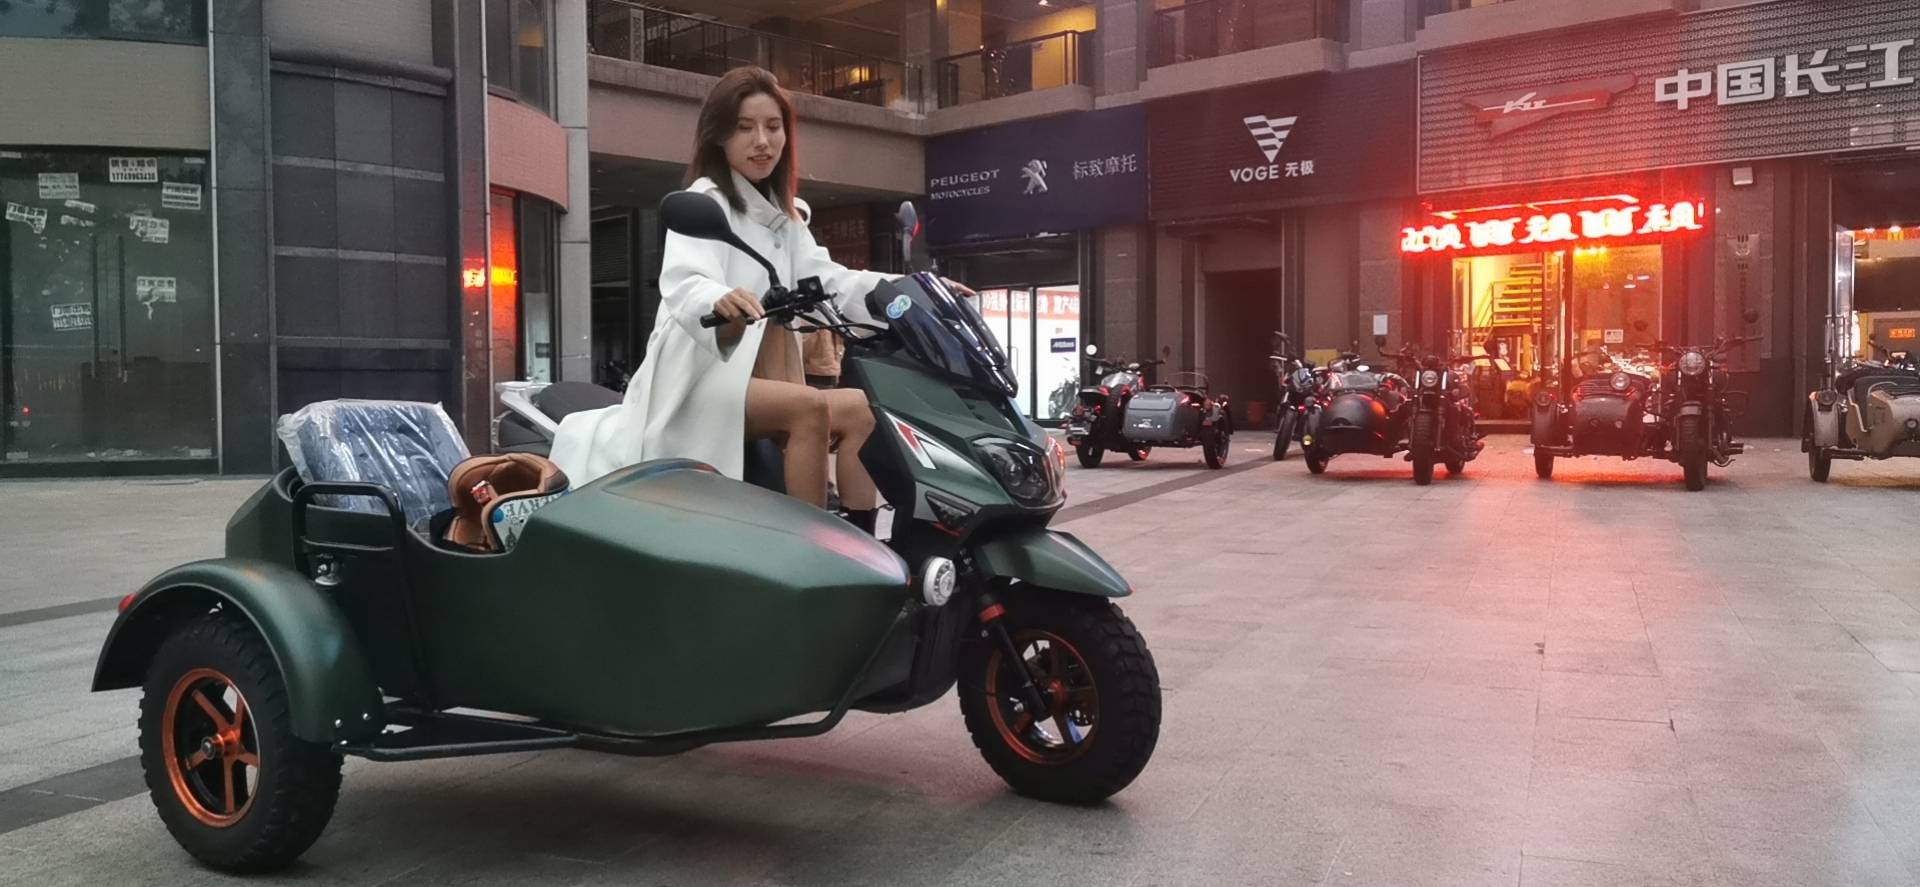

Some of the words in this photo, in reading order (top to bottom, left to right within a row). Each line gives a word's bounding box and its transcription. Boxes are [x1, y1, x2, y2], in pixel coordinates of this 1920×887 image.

[1655, 38, 1914, 111] 中国长江
[930, 168, 1000, 188] PEUGEOT
[1073, 153, 1137, 180] 标致摩托
[1229, 164, 1280, 183] VOGE
[1285, 160, 1314, 177] 无极
